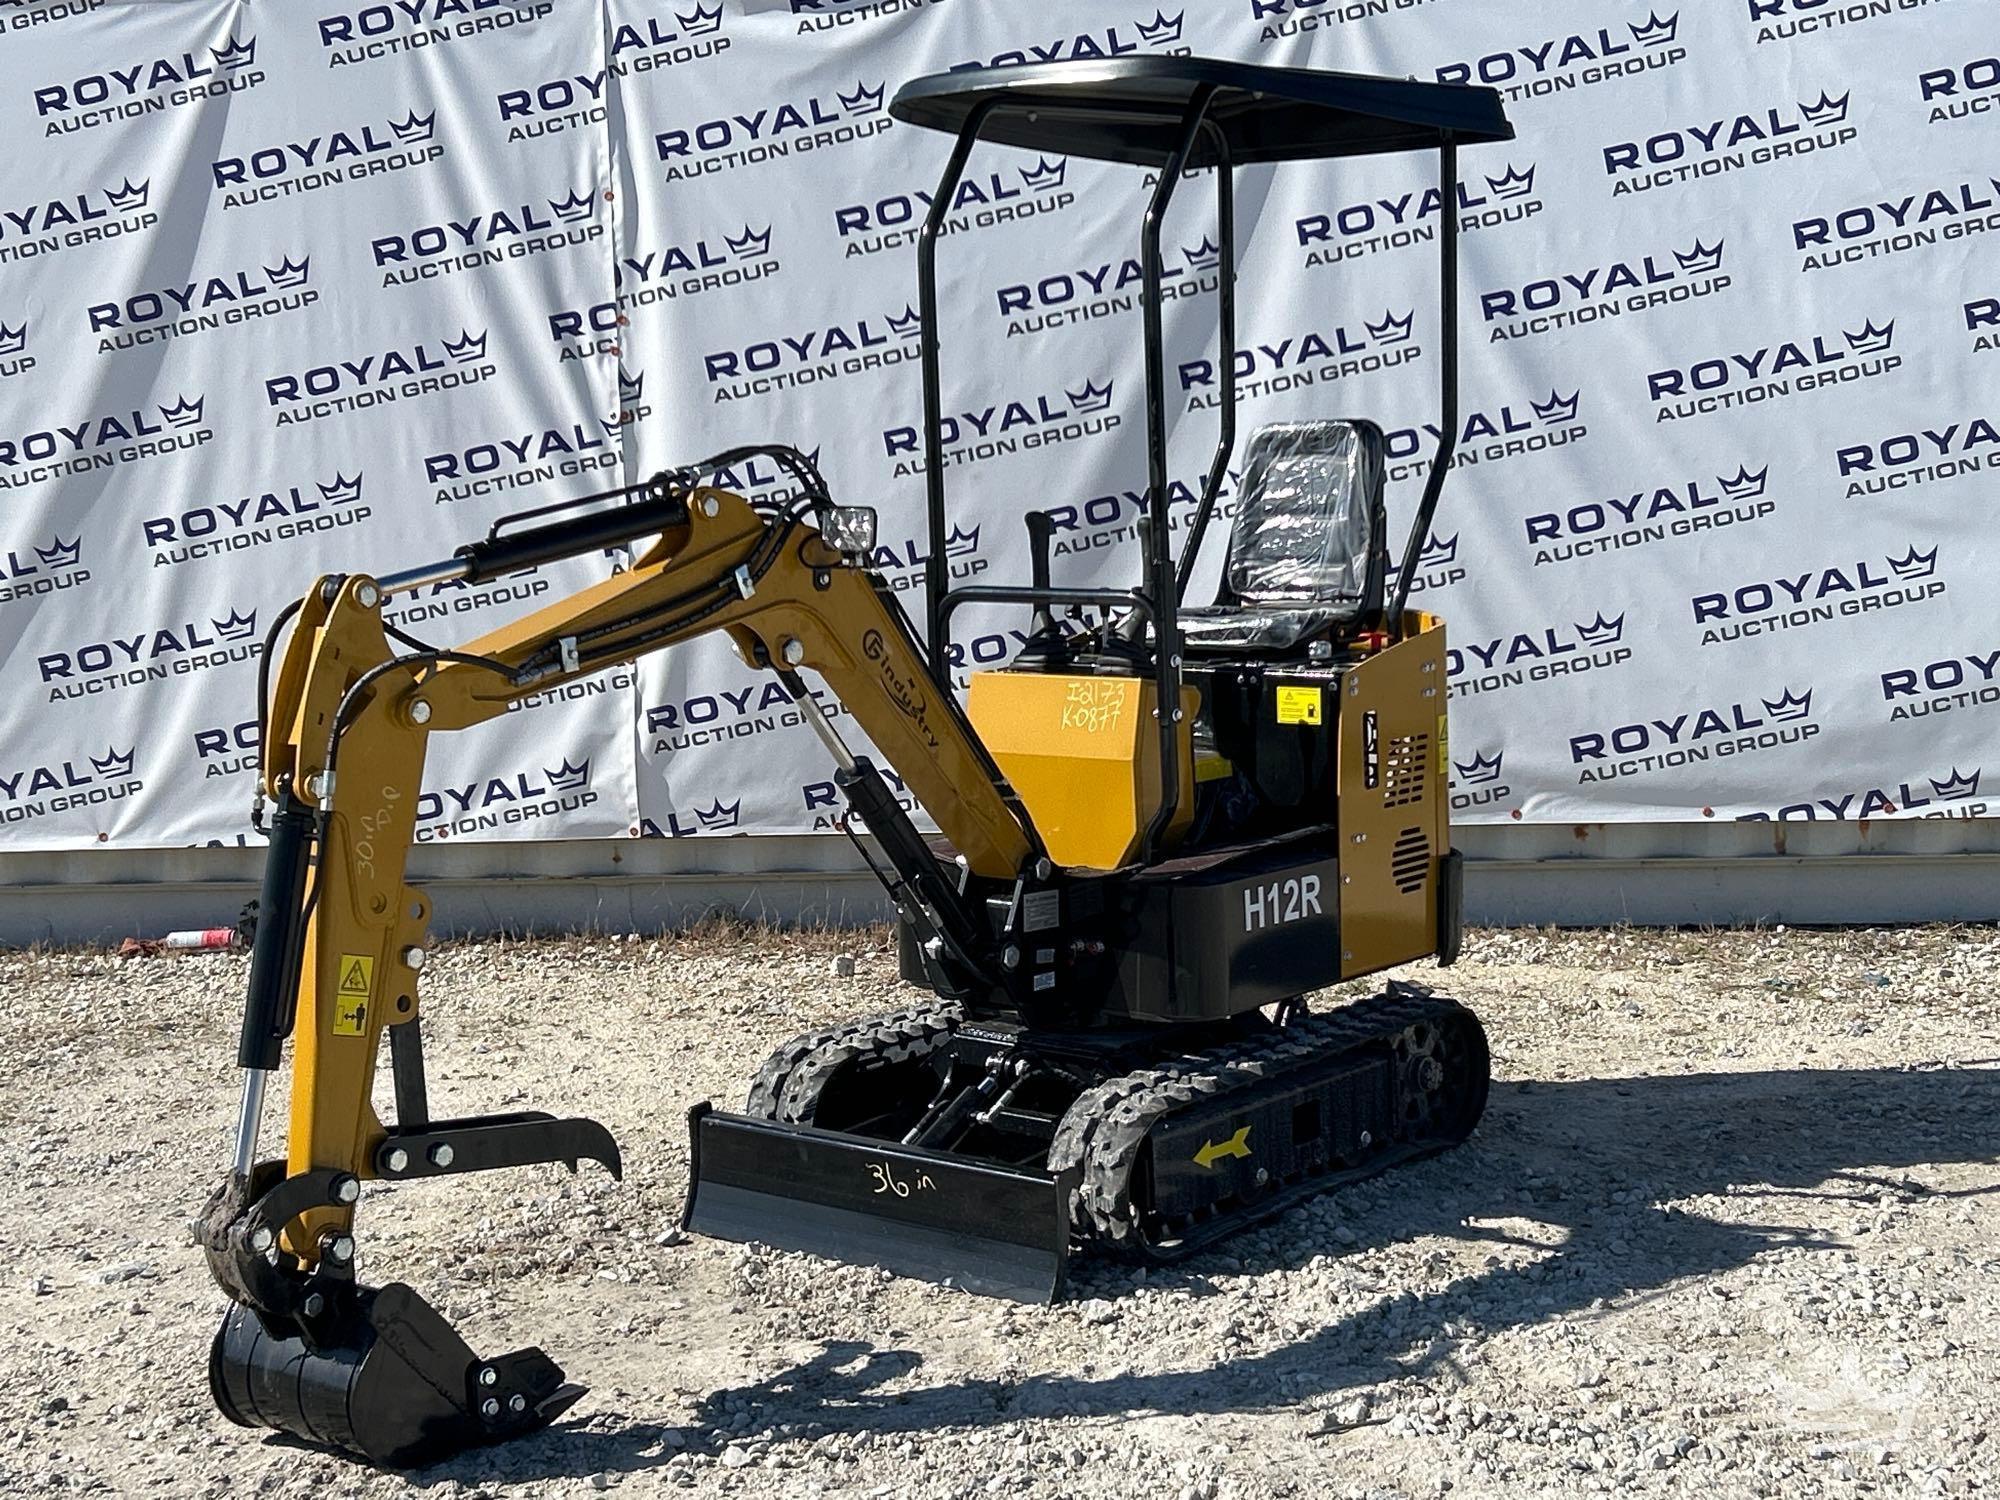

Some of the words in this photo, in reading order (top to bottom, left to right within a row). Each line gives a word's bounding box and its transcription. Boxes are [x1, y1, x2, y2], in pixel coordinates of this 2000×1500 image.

[11, 0, 106, 30] GROUP
[329, 27, 450, 68] AUCTION
[456, 3, 553, 38] GROUP
[1260, 0, 1389, 42] AUCTION
[1757, 0, 1892, 44] AUCTION
[34, 53, 213, 117] ROYAL
[633, 38, 731, 73] GROUP
[1581, 48, 1687, 85] GROUP
[45, 96, 164, 138] AUCTION
[170, 71, 265, 107] GROUP
[497, 69, 605, 121] ROY
[508, 107, 607, 143] AUCTIO
[212, 126, 392, 189] ROYAL
[655, 98, 840, 162] ROYAL
[665, 142, 789, 183] AUCTION
[794, 118, 894, 153] GROUP
[1601, 108, 1801, 175] ROYAL
[223, 169, 343, 210] AUCTION
[348, 145, 445, 180] GROUP
[1612, 153, 1745, 197] AUCTION
[1751, 127, 1858, 165] GROUP
[64, 213, 159, 248] GROUP
[372, 205, 551, 267] ROYAL
[975, 193, 1075, 228] GROUP
[1294, 182, 1488, 247] ROYAL
[1791, 184, 1993, 250] ROYAL
[383, 248, 503, 288] AUCTION
[508, 224, 604, 259] GROUP
[683, 260, 779, 295] GROUP
[1305, 226, 1434, 269] AUCTION
[1802, 229, 1937, 272] AUCTION
[88, 272, 267, 333] ROYAL
[1007, 296, 1132, 338] AUCTION
[1479, 257, 1676, 322] ROYAL
[1489, 301, 1621, 344] AUCTION
[1626, 276, 1732, 312] GROUP
[99, 314, 218, 354] AUCTION
[224, 290, 320, 325] GROUP
[704, 321, 888, 383] ROYAL
[265, 345, 445, 406] ROYAL
[715, 363, 837, 404] AUCTION
[842, 344, 920, 375] GROU
[1319, 346, 1422, 382] GROUP
[1645, 337, 1846, 401] ROYAL
[1656, 381, 1790, 423] AUCTION
[1795, 356, 1903, 392] GROUP
[276, 387, 396, 427] AUCTION
[401, 364, 498, 398] GROUP
[118, 429, 214, 463] GROUP
[425, 424, 603, 484] ROYAL
[1022, 415, 1122, 449] GROUP
[1484, 426, 1588, 461] GROUP
[1835, 419, 2000, 477] ROYA
[436, 465, 555, 505] AUCTION
[1846, 457, 1981, 499] AUCTION
[143, 488, 320, 548] ROYAL
[154, 529, 272, 568] AUCTION
[277, 506, 372, 540] GROUP
[1523, 482, 1720, 545] ROYAL
[1534, 525, 1665, 566] AUCTION
[1670, 501, 1776, 536] GROUP
[453, 580, 549, 613] GROUP
[1690, 562, 1890, 625] ROYAL
[1701, 605, 1834, 646] AUCTION
[1839, 582, 1946, 616] GROUP
[39, 624, 214, 683] ROYAL
[50, 664, 167, 703] AUCTION
[172, 642, 263, 675] GROUP
[1529, 648, 1632, 682] GROUP
[1879, 649, 2000, 701] ROY
[1568, 704, 1765, 764] ROYAL
[1890, 687, 2000, 722] AUCTIO
[654, 717, 775, 755] AUCTION
[1578, 746, 1710, 785] AUCTION
[1715, 724, 1820, 757] GROUP
[50, 780, 144, 813] GROUP
[417, 773, 547, 822] OYAL
[503, 792, 598, 824] GROUP
[1244, 875, 1322, 931] H12R
[865, 1161, 909, 1197] 36
[915, 1168, 936, 1191] in
